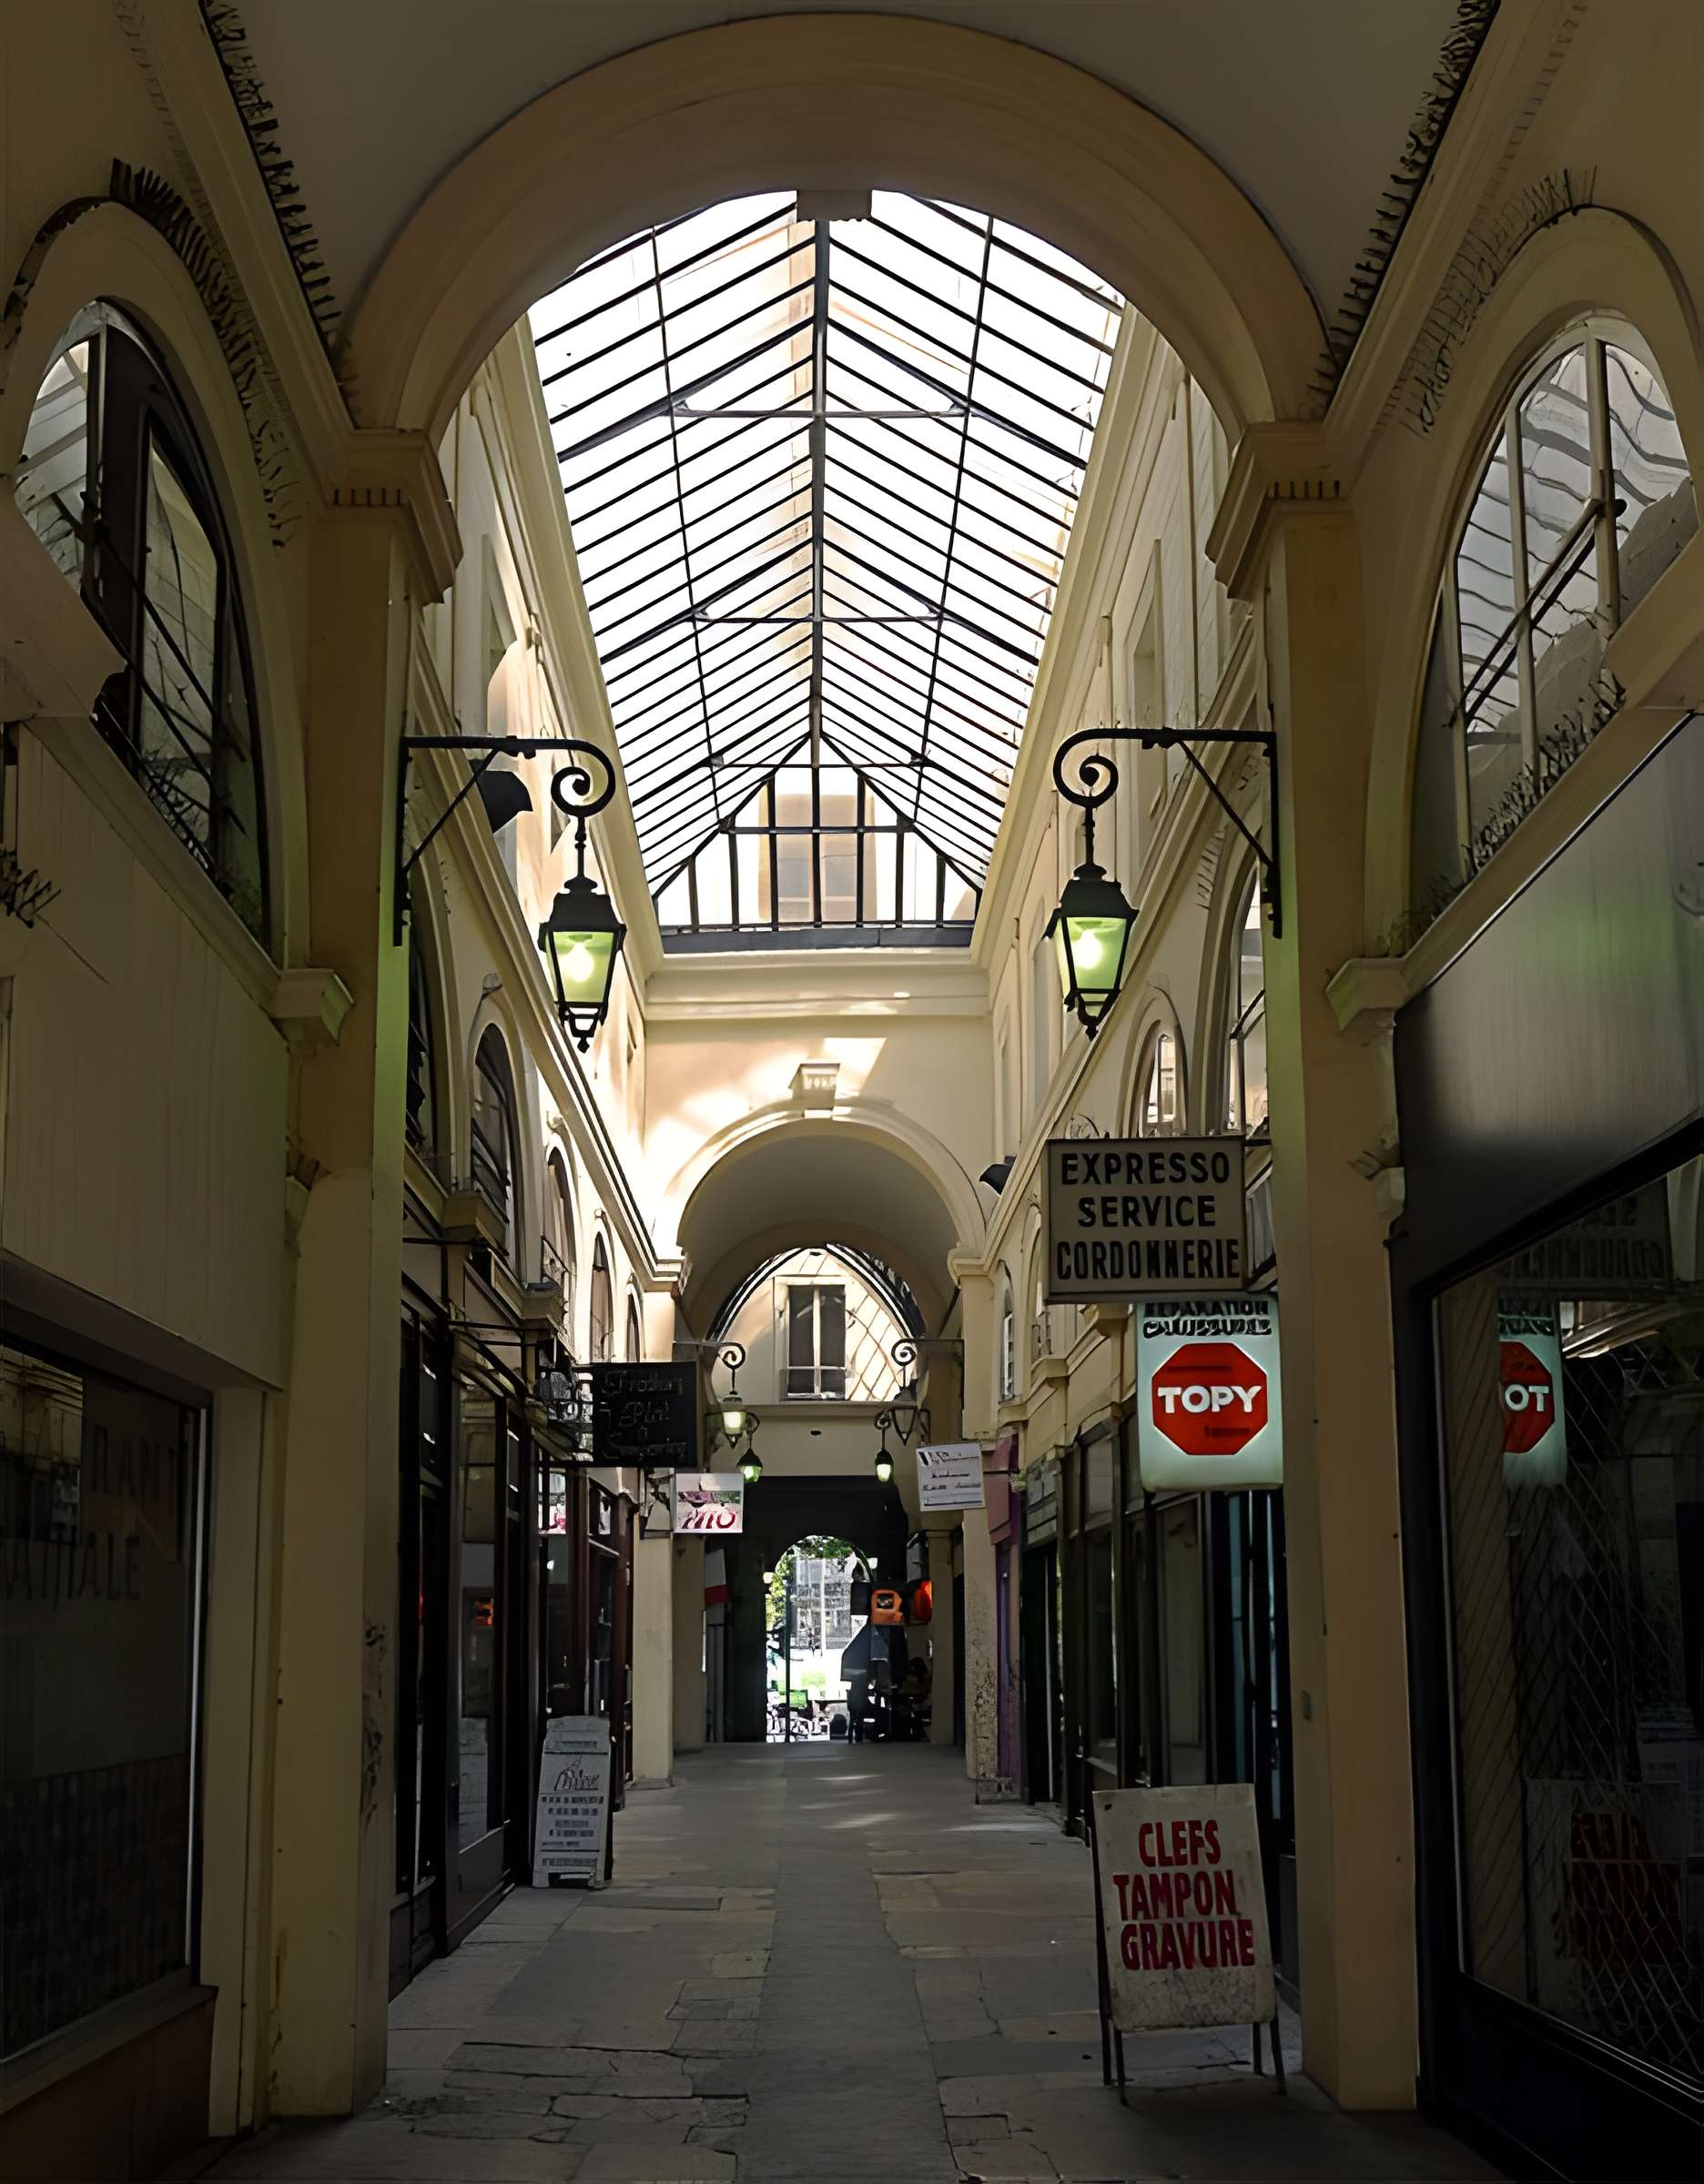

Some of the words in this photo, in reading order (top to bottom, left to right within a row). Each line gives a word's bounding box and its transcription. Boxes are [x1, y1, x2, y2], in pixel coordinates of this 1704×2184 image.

[1060, 1151, 1231, 1186] EXPRESSO
[1078, 1194, 1217, 1228] SERVICE
[1057, 1239, 1240, 1280] CORDONNERIE
[1157, 1385, 1262, 1413] TOPY
[1138, 1819, 1221, 1867] CLEFS
[1112, 1869, 1237, 1921] TAMPON
[1121, 1919, 1255, 1971] GRAVURE
